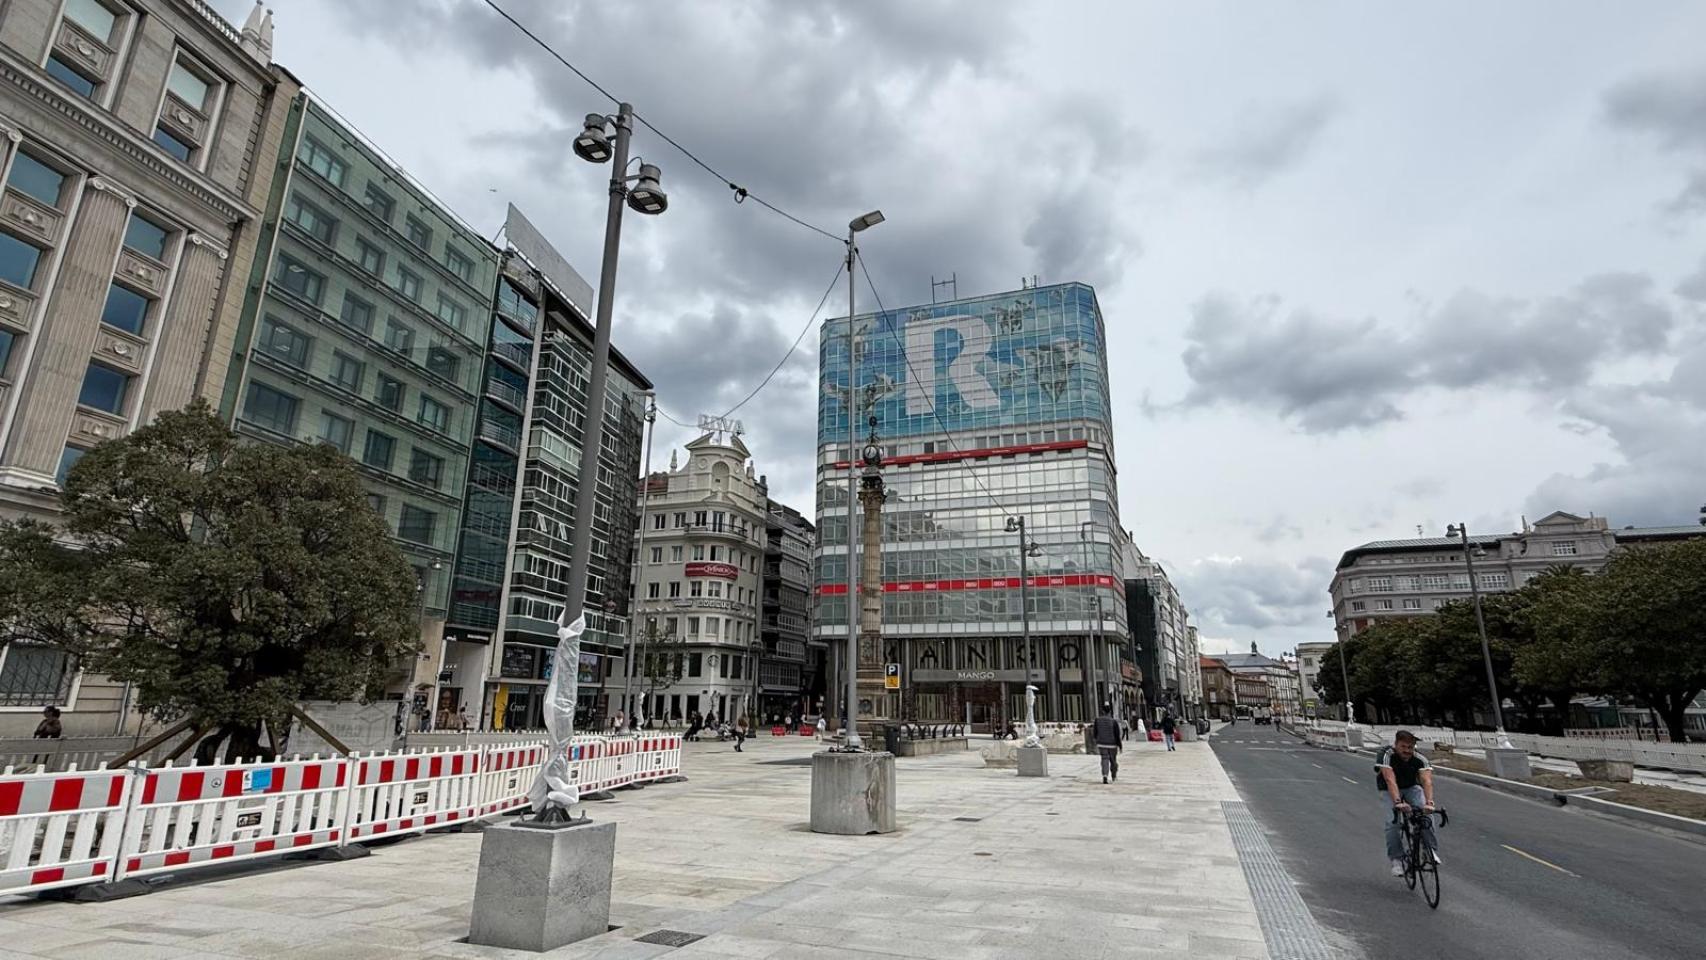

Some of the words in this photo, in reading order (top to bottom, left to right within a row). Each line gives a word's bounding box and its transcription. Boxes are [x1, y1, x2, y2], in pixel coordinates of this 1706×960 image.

[905, 315, 1001, 416] R
[888, 665, 896, 675] P
[958, 671, 995, 680] MANGO
